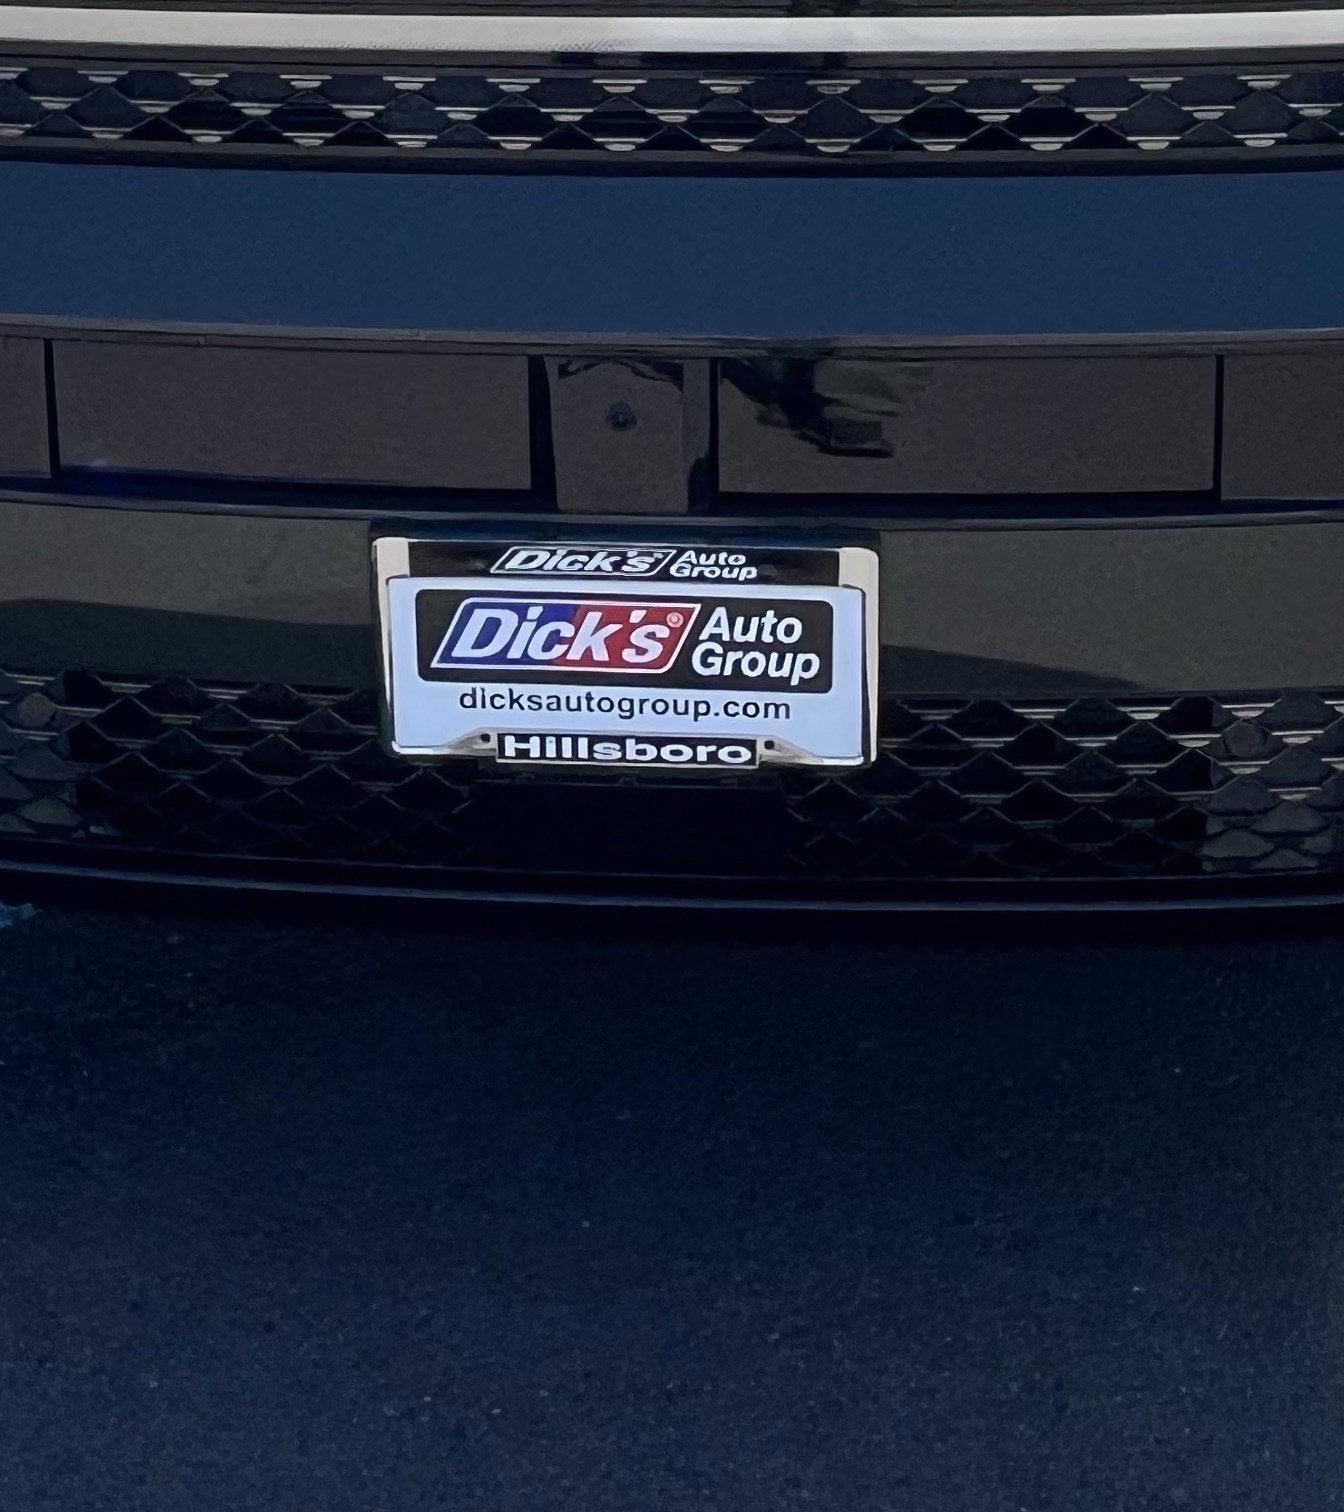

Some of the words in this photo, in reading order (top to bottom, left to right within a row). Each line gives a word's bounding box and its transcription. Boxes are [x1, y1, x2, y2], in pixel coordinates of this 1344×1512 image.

[504, 548, 658, 574] Dick's
[678, 550, 747, 566] Auto
[669, 563, 758, 581] Group
[451, 605, 669, 665] Dick's
[699, 607, 803, 645] Auto
[691, 646, 821, 686] Group
[459, 686, 792, 721] dicksautogroup.com
[503, 734, 753, 764] Hillsboro
